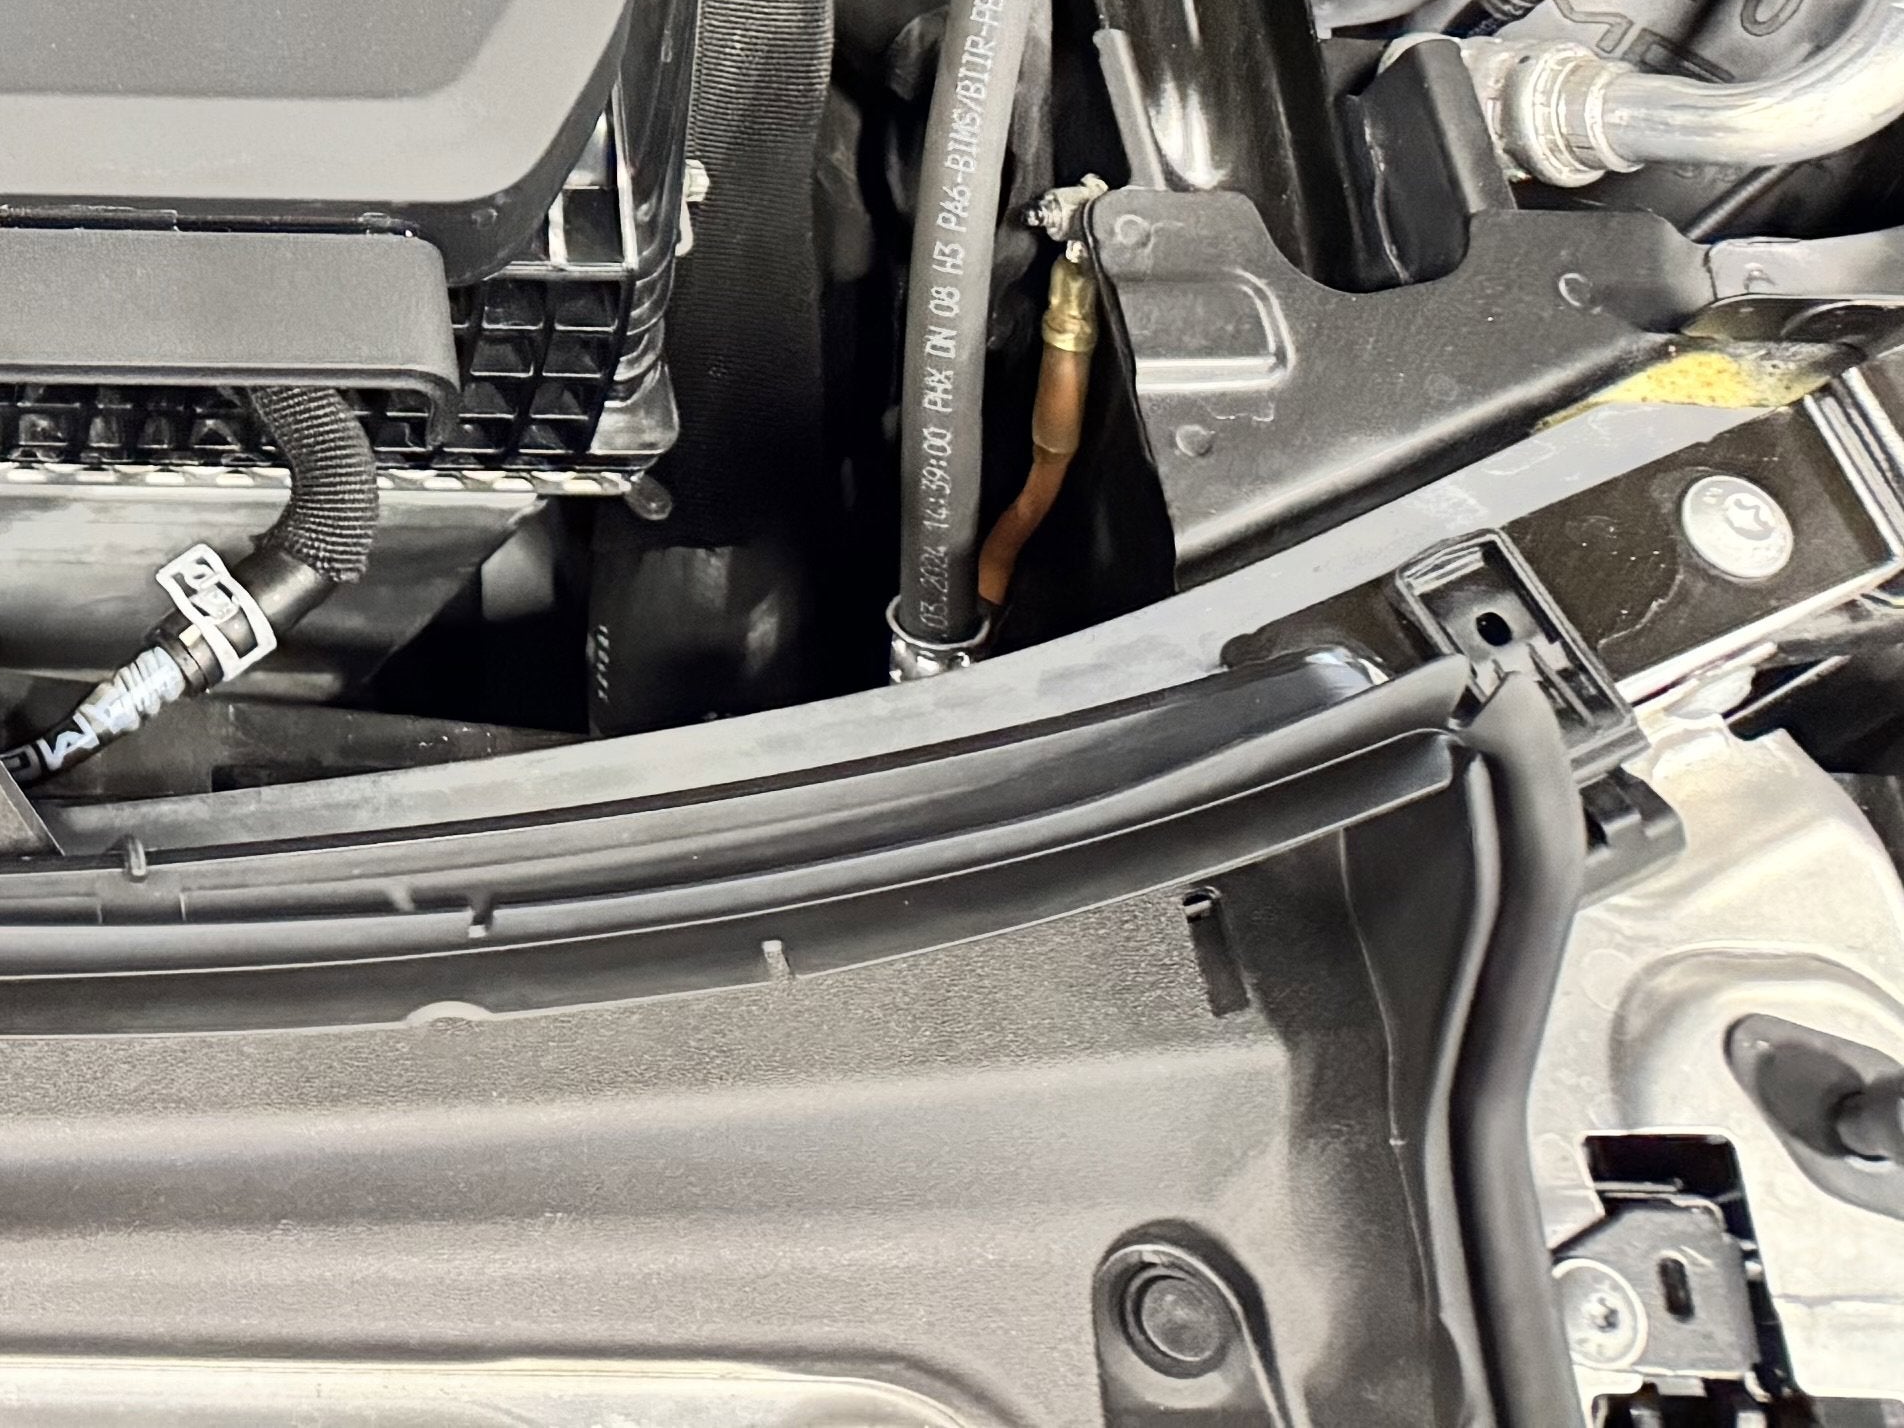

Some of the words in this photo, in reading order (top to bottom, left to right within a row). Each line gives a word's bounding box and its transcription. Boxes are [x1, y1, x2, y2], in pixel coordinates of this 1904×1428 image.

[932, 241, 965, 276] H3
[928, 285, 962, 318] 08
[924, 326, 958, 360] DN
[922, 367, 955, 413] PHX
[921, 426, 953, 532] 14:39:00
